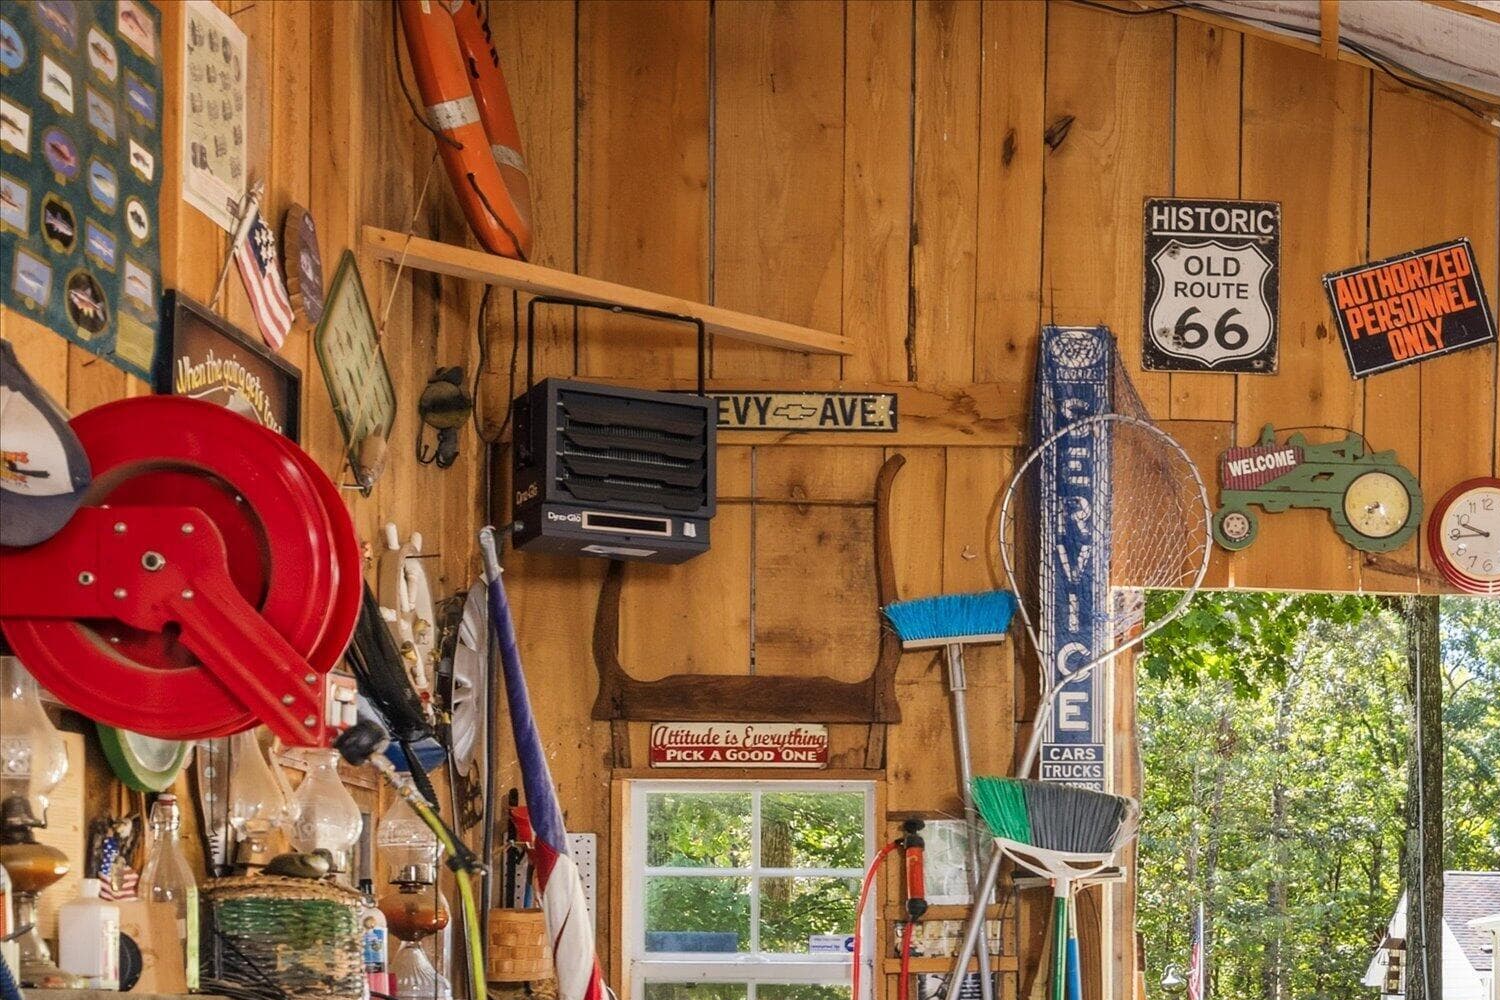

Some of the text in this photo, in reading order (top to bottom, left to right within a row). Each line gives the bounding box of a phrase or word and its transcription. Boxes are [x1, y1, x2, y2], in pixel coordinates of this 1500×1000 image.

[1152, 206, 1274, 234] HISTORIC
[1184, 256, 1241, 277] OLD
[1335, 247, 1471, 310] AUTHORIZED
[1174, 281, 1249, 300] ROUTE
[1345, 277, 1478, 340] PERSONNEL
[1174, 306, 1249, 351] 66
[1387, 316, 1445, 361] ONLY
[205, 349, 223, 385] the
[716, 396, 773, 426] EVY
[1228, 449, 1296, 477] WELCOME
[1482, 498, 1494, 511] 12
[1056, 397, 1092, 732] SERVICE
[1469, 556, 1478, 568] 7
[1482, 559, 1493, 572] 6
[653, 725, 828, 752] Attitude is Everything
[666, 749, 817, 761] PICK A GOOD ONE
[1050, 748, 1096, 760] CARS
[1044, 765, 1101, 777] TRUCKS
